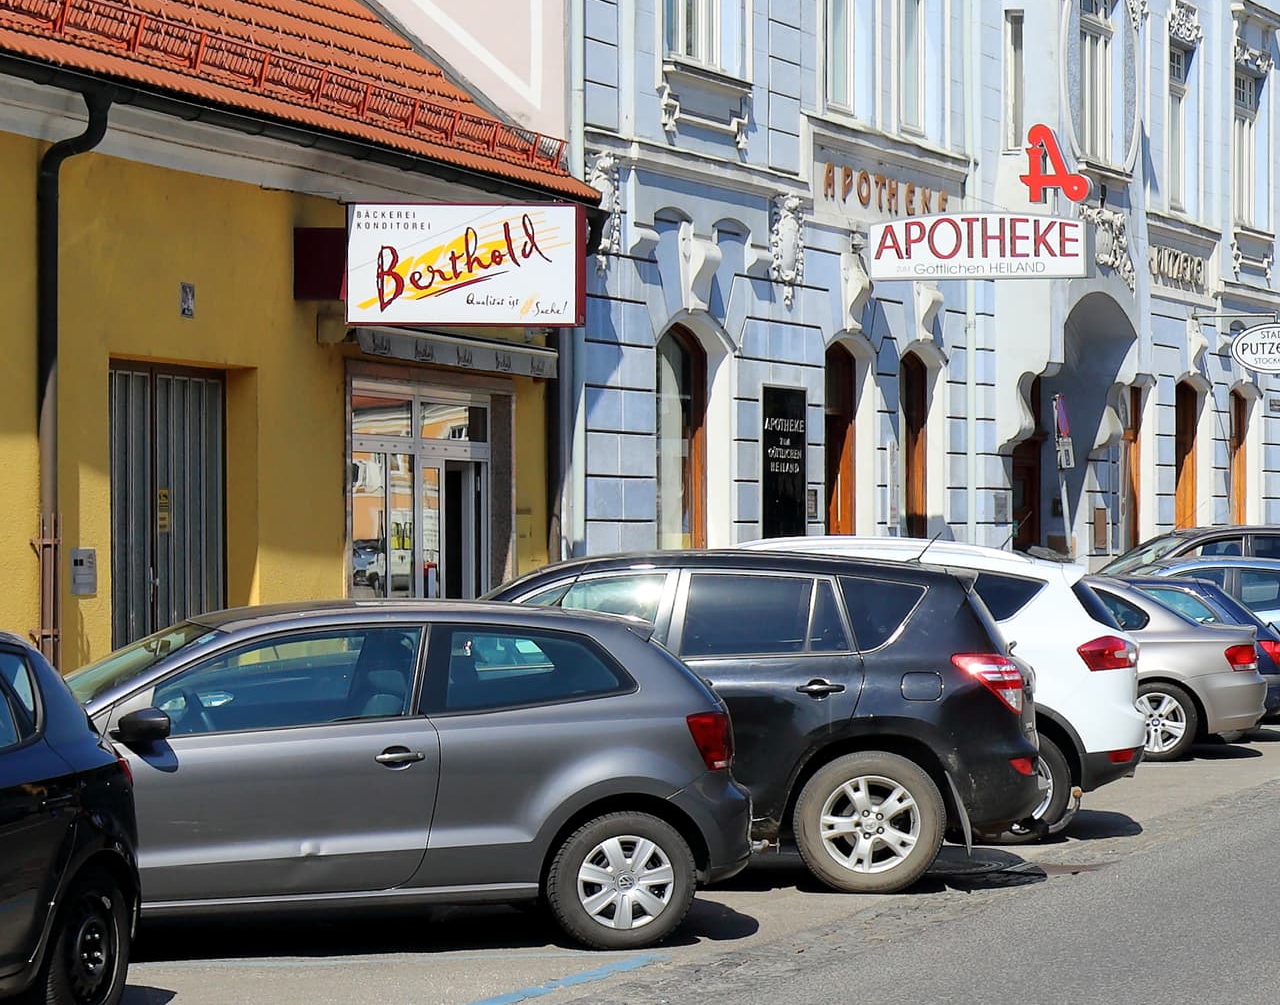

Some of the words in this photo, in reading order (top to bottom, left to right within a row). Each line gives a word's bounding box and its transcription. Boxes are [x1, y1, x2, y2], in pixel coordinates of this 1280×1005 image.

[823, 161, 949, 216] APOTHEKE
[356, 221, 432, 231] KONDITOREI
[873, 216, 1080, 261] APOTHEKE
[376, 213, 553, 313] Berthold
[988, 261, 1046, 275] HEILAND
[764, 417, 805, 433] APOTHEKE
[770, 461, 800, 473] HEILAND
